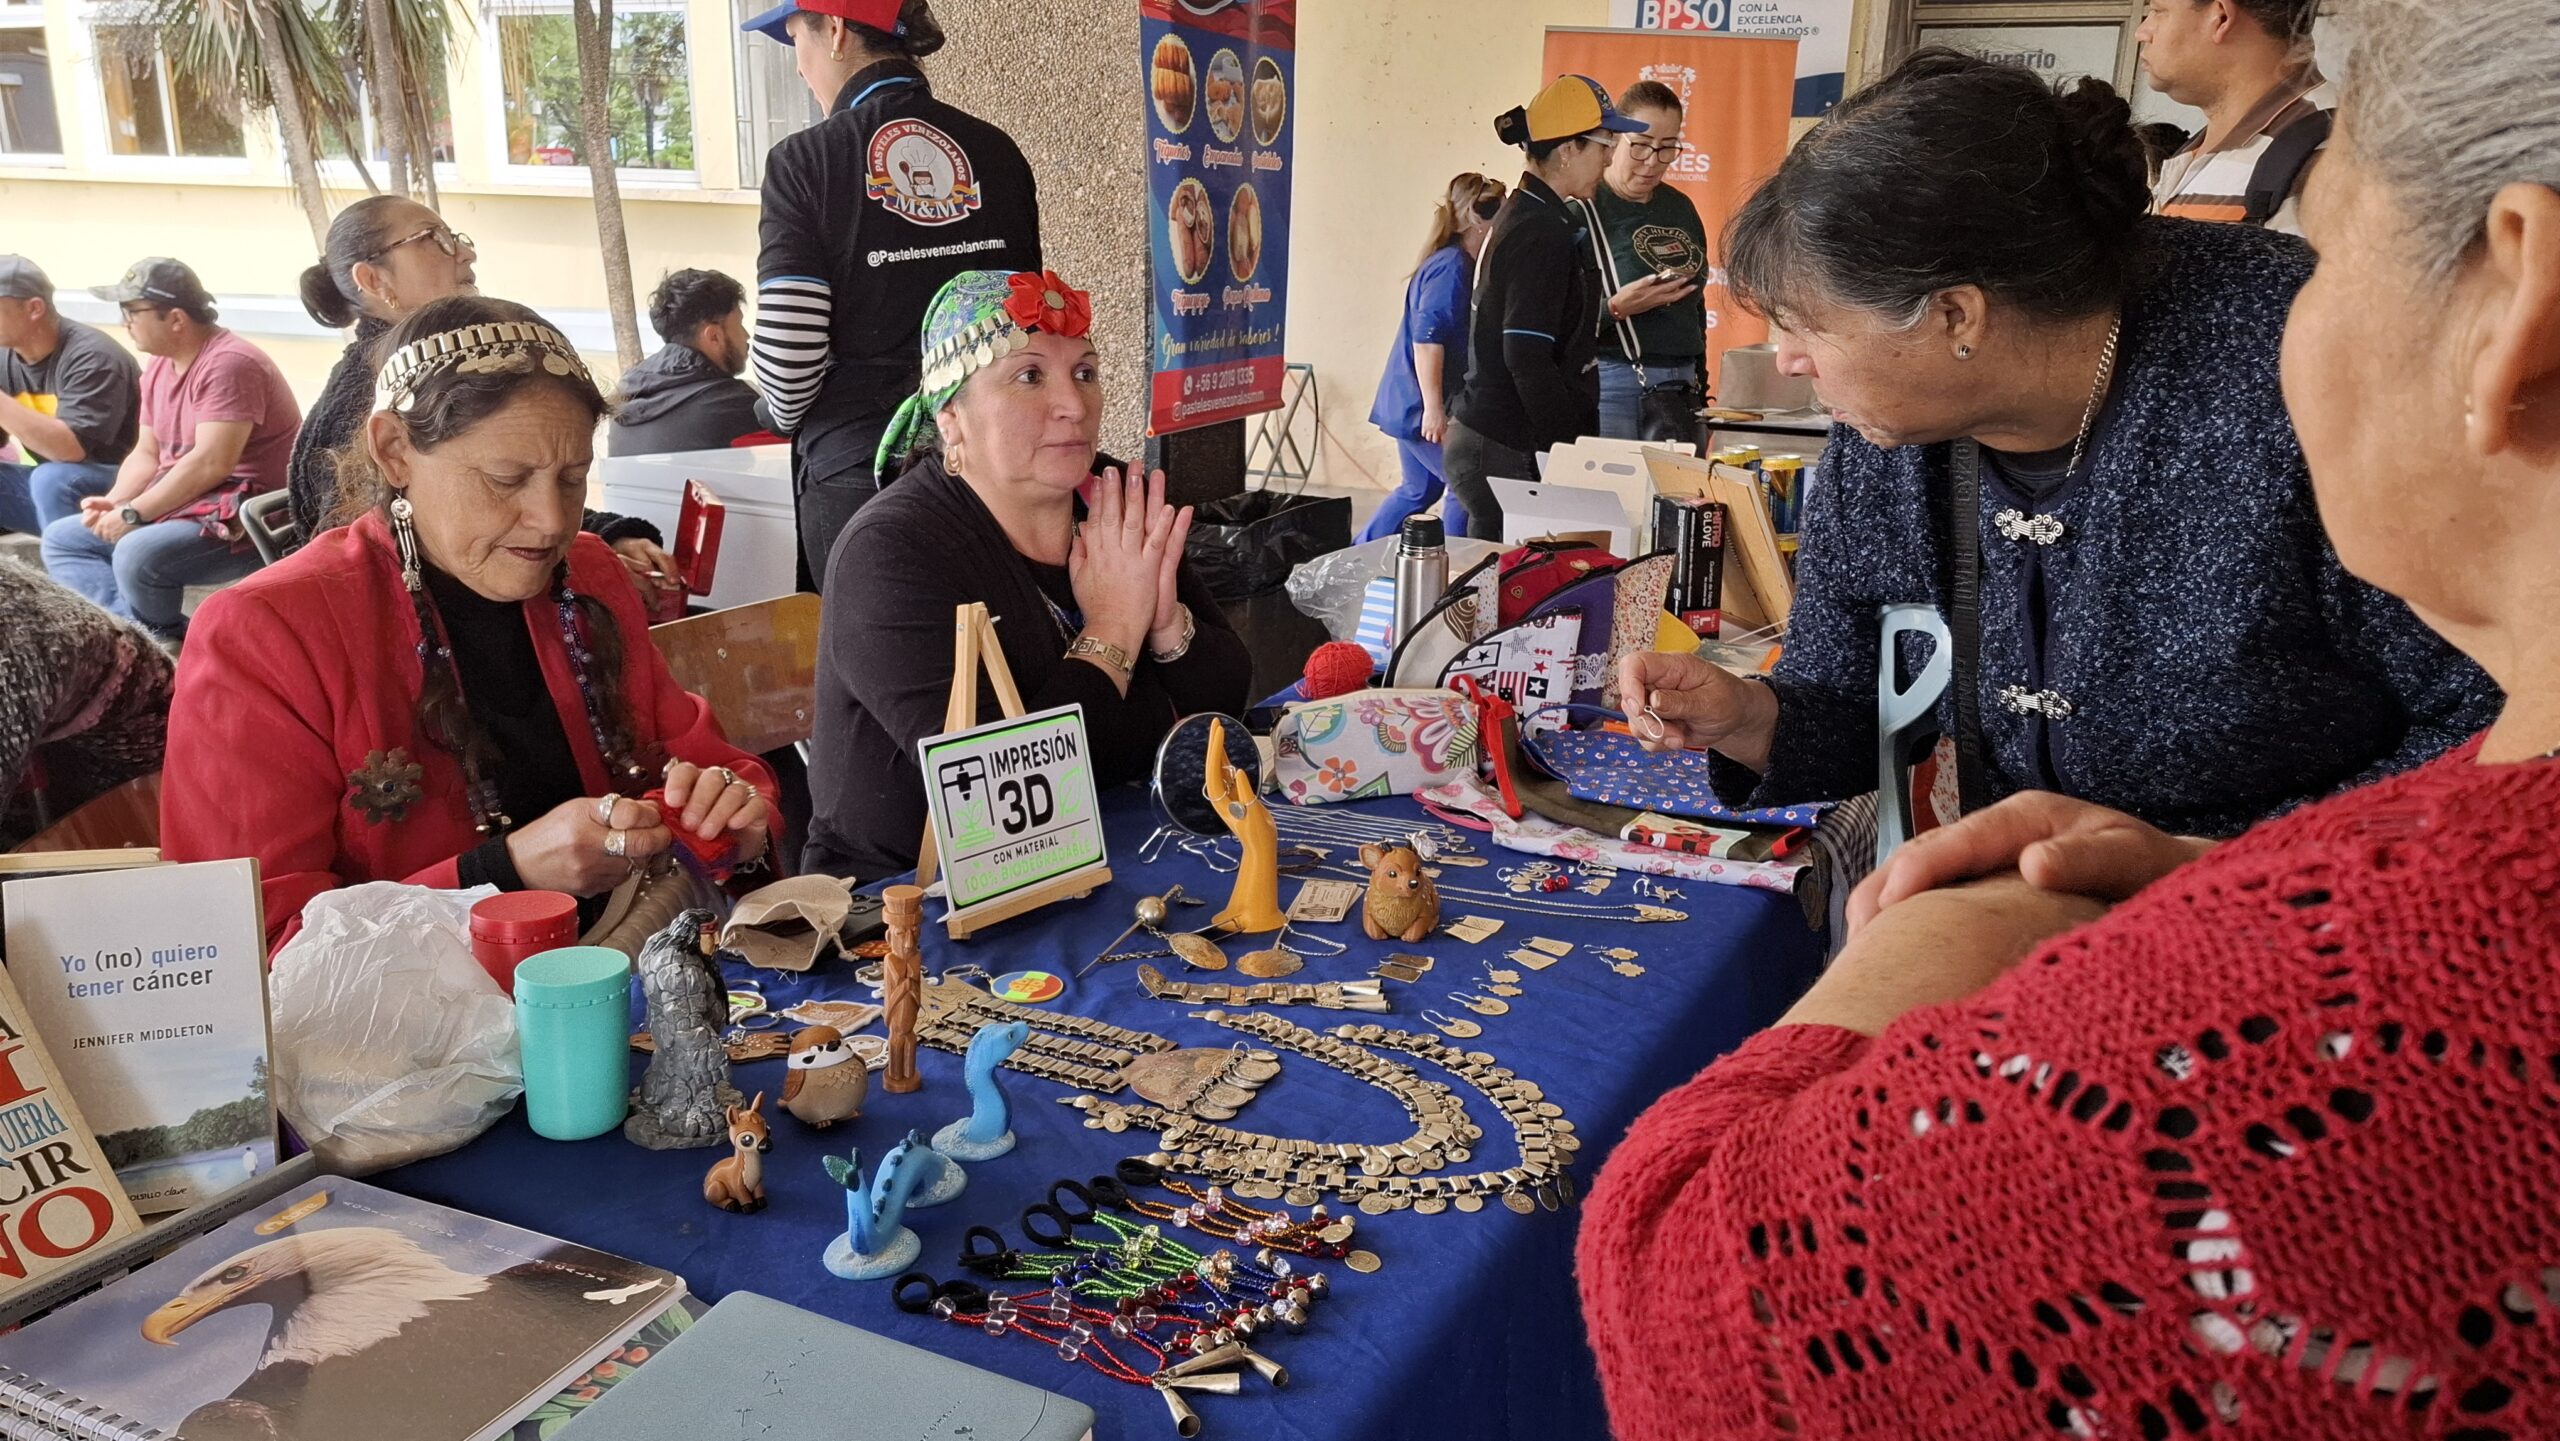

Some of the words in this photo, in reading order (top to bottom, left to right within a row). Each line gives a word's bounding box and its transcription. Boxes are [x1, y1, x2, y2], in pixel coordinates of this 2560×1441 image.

[1643, 0, 1725, 29] BPSO
[1737, 15, 1802, 25] EXCELENCIA
[1738, 4, 1762, 13] CON
[1765, 4, 1778, 12] LA
[875, 127, 901, 172] PASTELES
[902, 124, 966, 181] VENEZOLANOS
[895, 193, 960, 219] M&M
[1212, 372, 1218, 390] 9
[1702, 511, 1712, 548] GLOVE
[1712, 510, 1723, 548] NITRO
[989, 728, 1078, 779] IMPRESIÓN
[998, 773, 1055, 836] 3D
[993, 850, 1013, 865] CON
[1015, 835, 1059, 857] MATERIAL
[965, 871, 998, 892] 100%
[1001, 839, 1092, 881] BIODEGRADABLE
[60, 955, 86, 973] Yo
[95, 947, 142, 972] (no)
[152, 944, 218, 968] quiero
[67, 979, 125, 999] tener
[133, 969, 213, 992] cáncer
[73, 1032, 134, 1049] JENNIFER
[140, 1024, 214, 1042] MIDDLETON
[129, 1191, 161, 1201] OLSILLO
